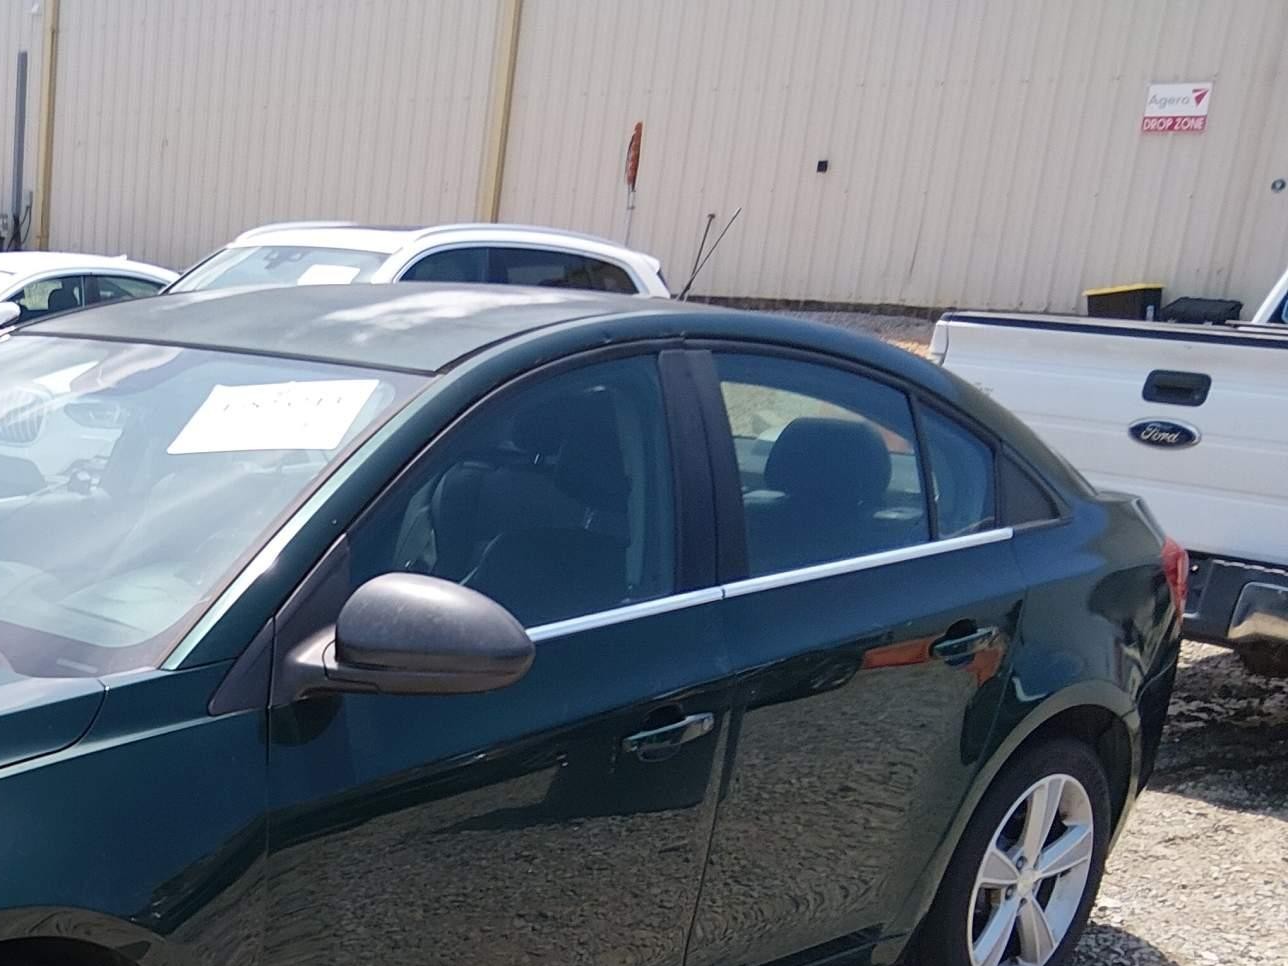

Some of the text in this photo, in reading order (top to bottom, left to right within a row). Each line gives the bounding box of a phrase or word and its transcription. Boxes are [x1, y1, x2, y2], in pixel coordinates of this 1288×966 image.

[1143, 116, 1205, 130] DROP ZONE
[1140, 422, 1181, 443] Ford
